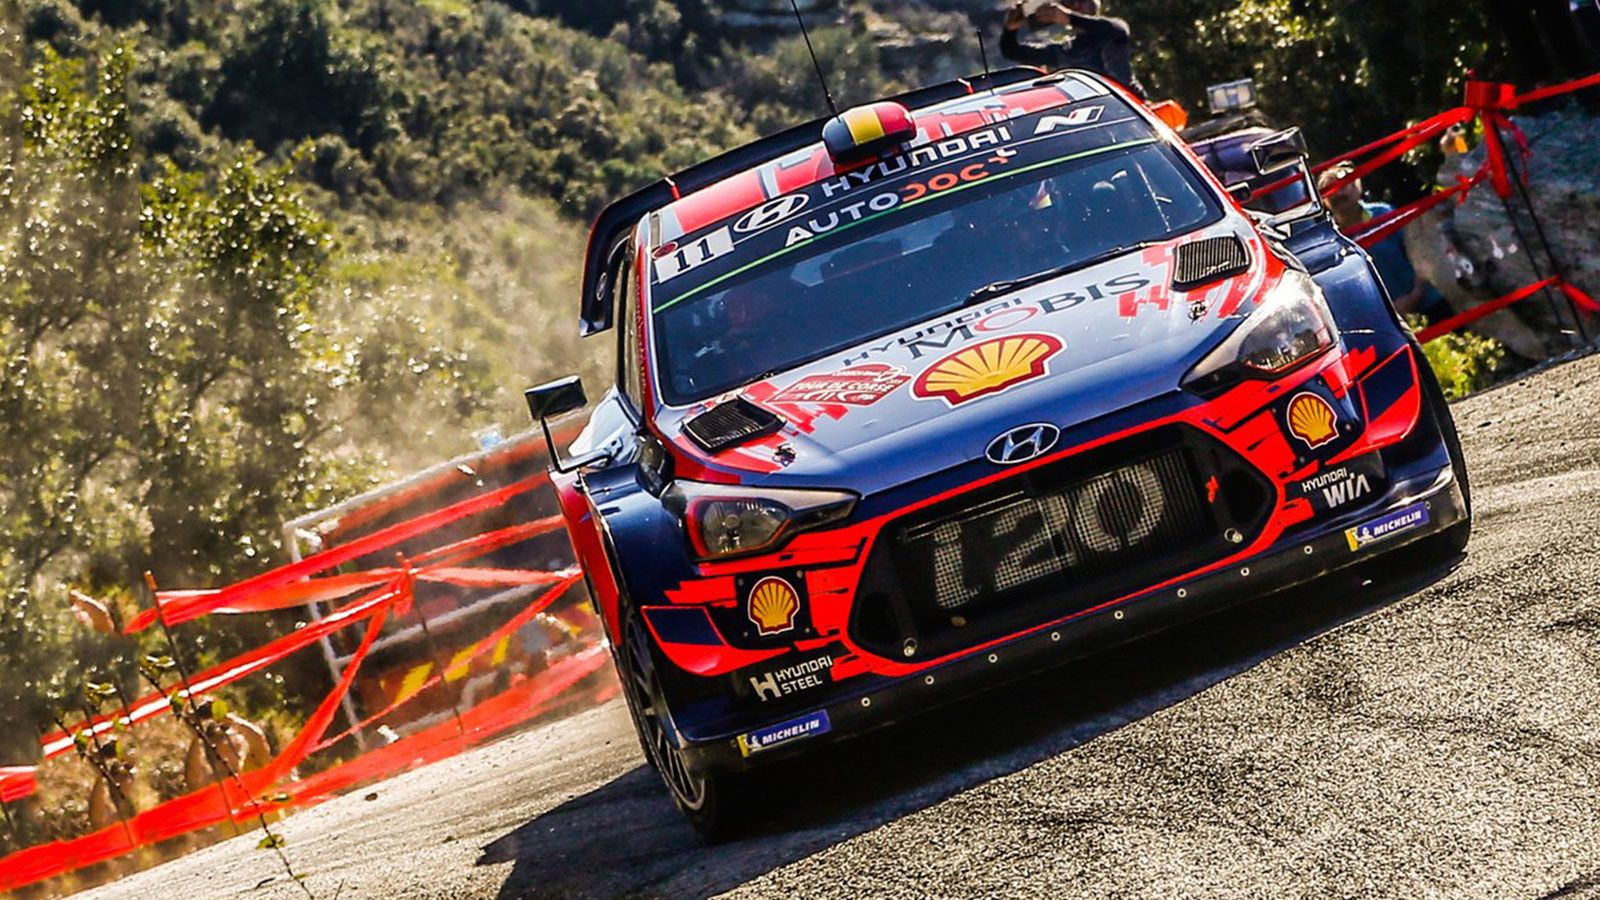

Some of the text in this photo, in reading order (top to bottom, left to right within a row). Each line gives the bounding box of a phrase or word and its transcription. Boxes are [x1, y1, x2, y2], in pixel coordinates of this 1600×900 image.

[822, 126, 1011, 198] HYUNDAI
[674, 238, 715, 272] 11
[906, 272, 1150, 360] MOBIS
[843, 298, 1022, 366] HYUNDAI
[1302, 467, 1347, 493] HYUNDAI
[1322, 472, 1371, 508] WIA
[1374, 510, 1421, 536] MICHELIN
[775, 655, 833, 681] HYUNDAI
[781, 675, 823, 694] STEEL
[762, 719, 820, 744] MICHELIN
